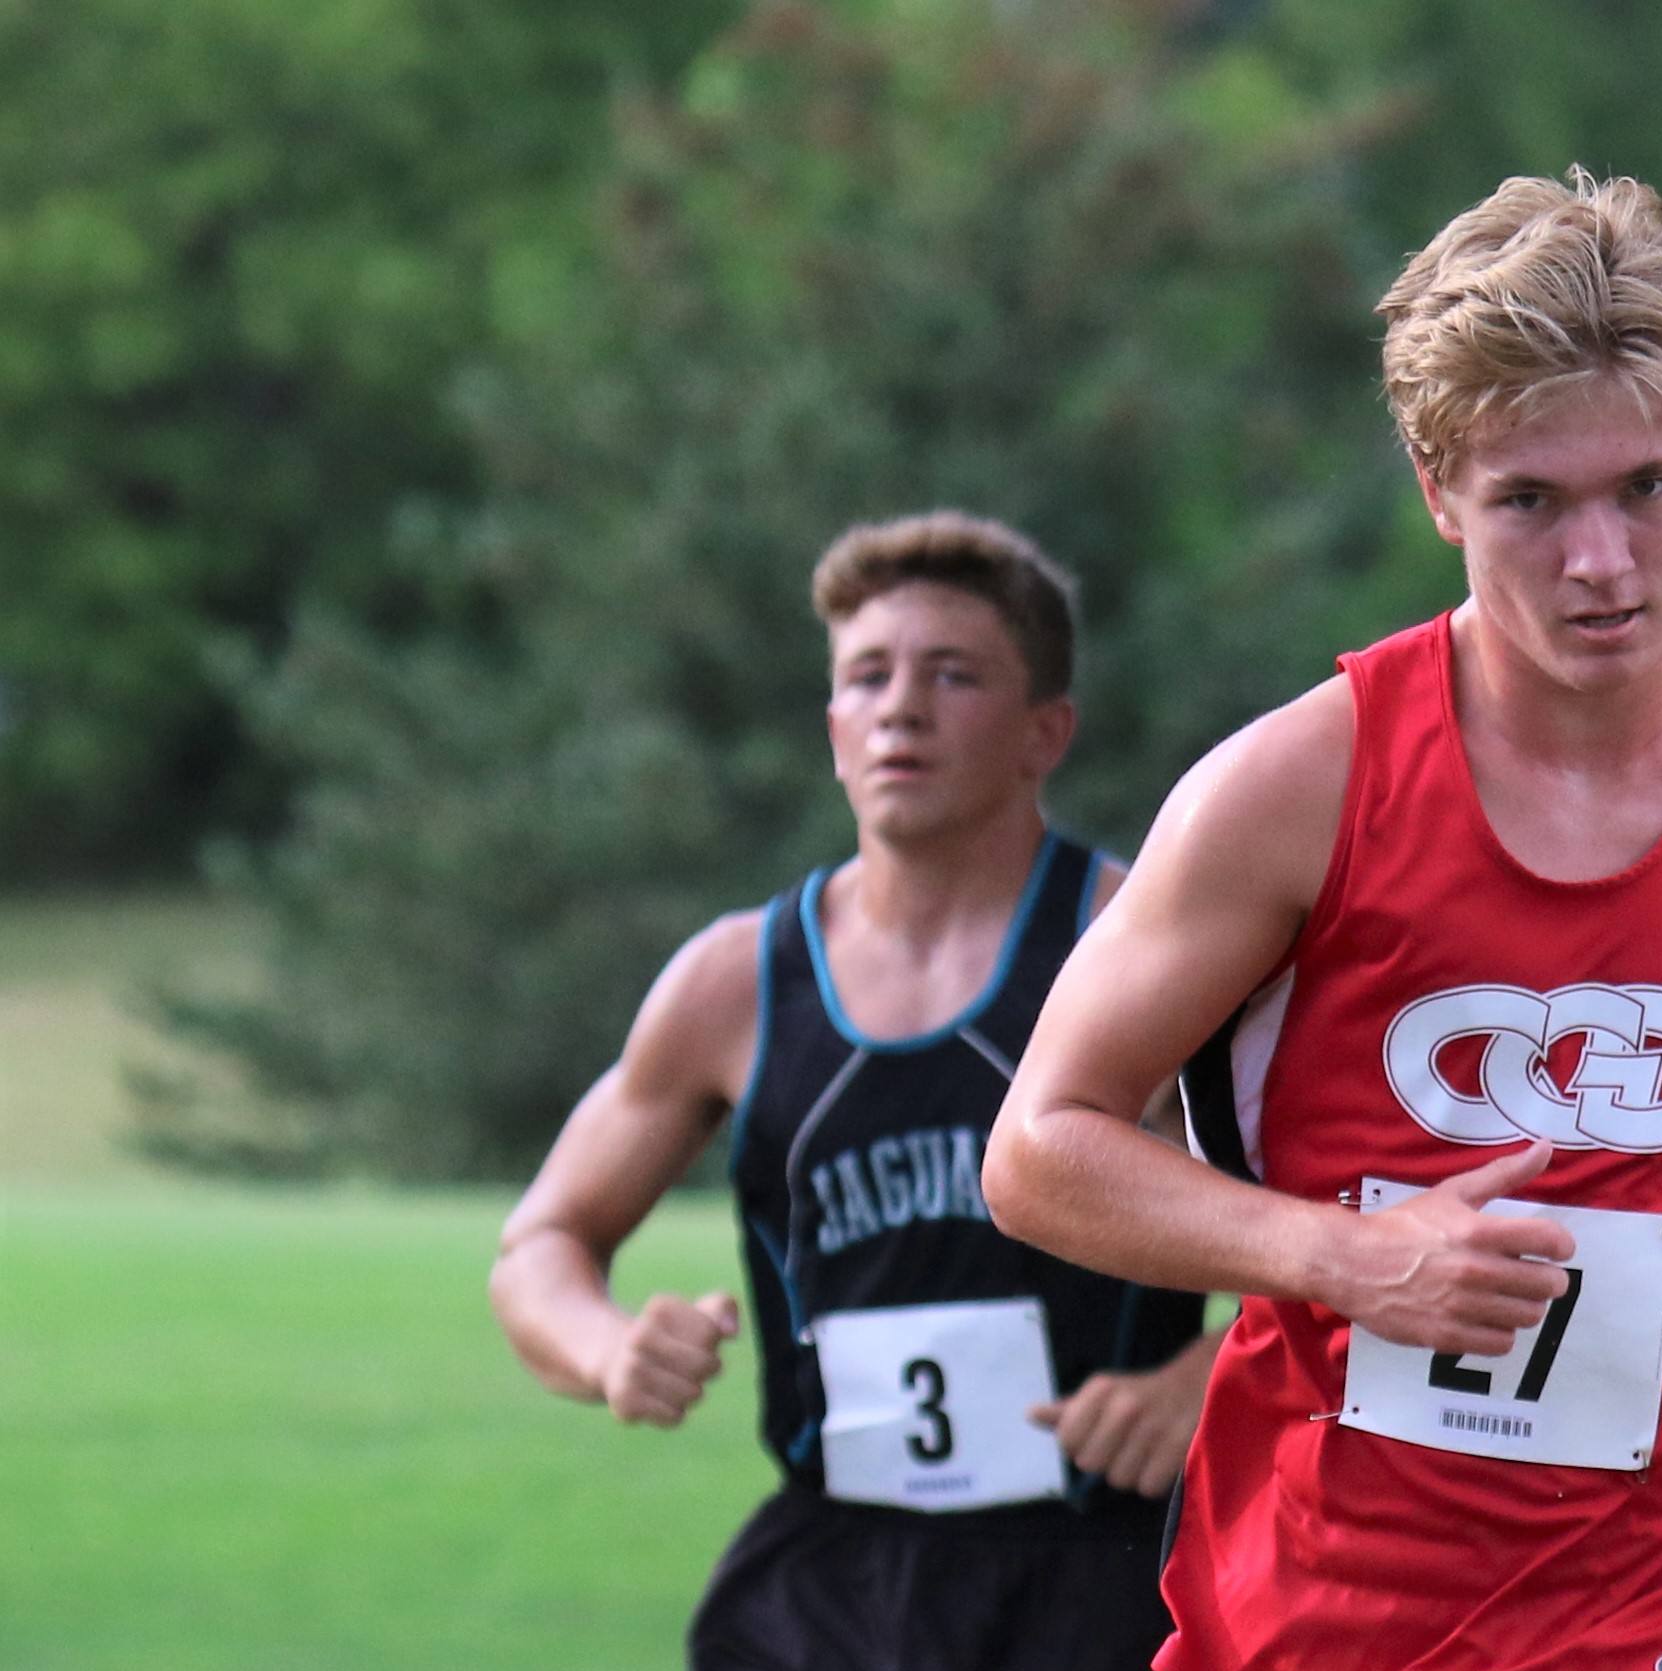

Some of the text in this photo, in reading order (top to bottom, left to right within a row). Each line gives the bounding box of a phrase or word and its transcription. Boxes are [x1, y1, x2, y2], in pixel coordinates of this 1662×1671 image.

[811, 1124, 990, 1253] JAGUA
[1428, 1267, 1583, 1402] 7
[902, 1359, 953, 1468] 3
